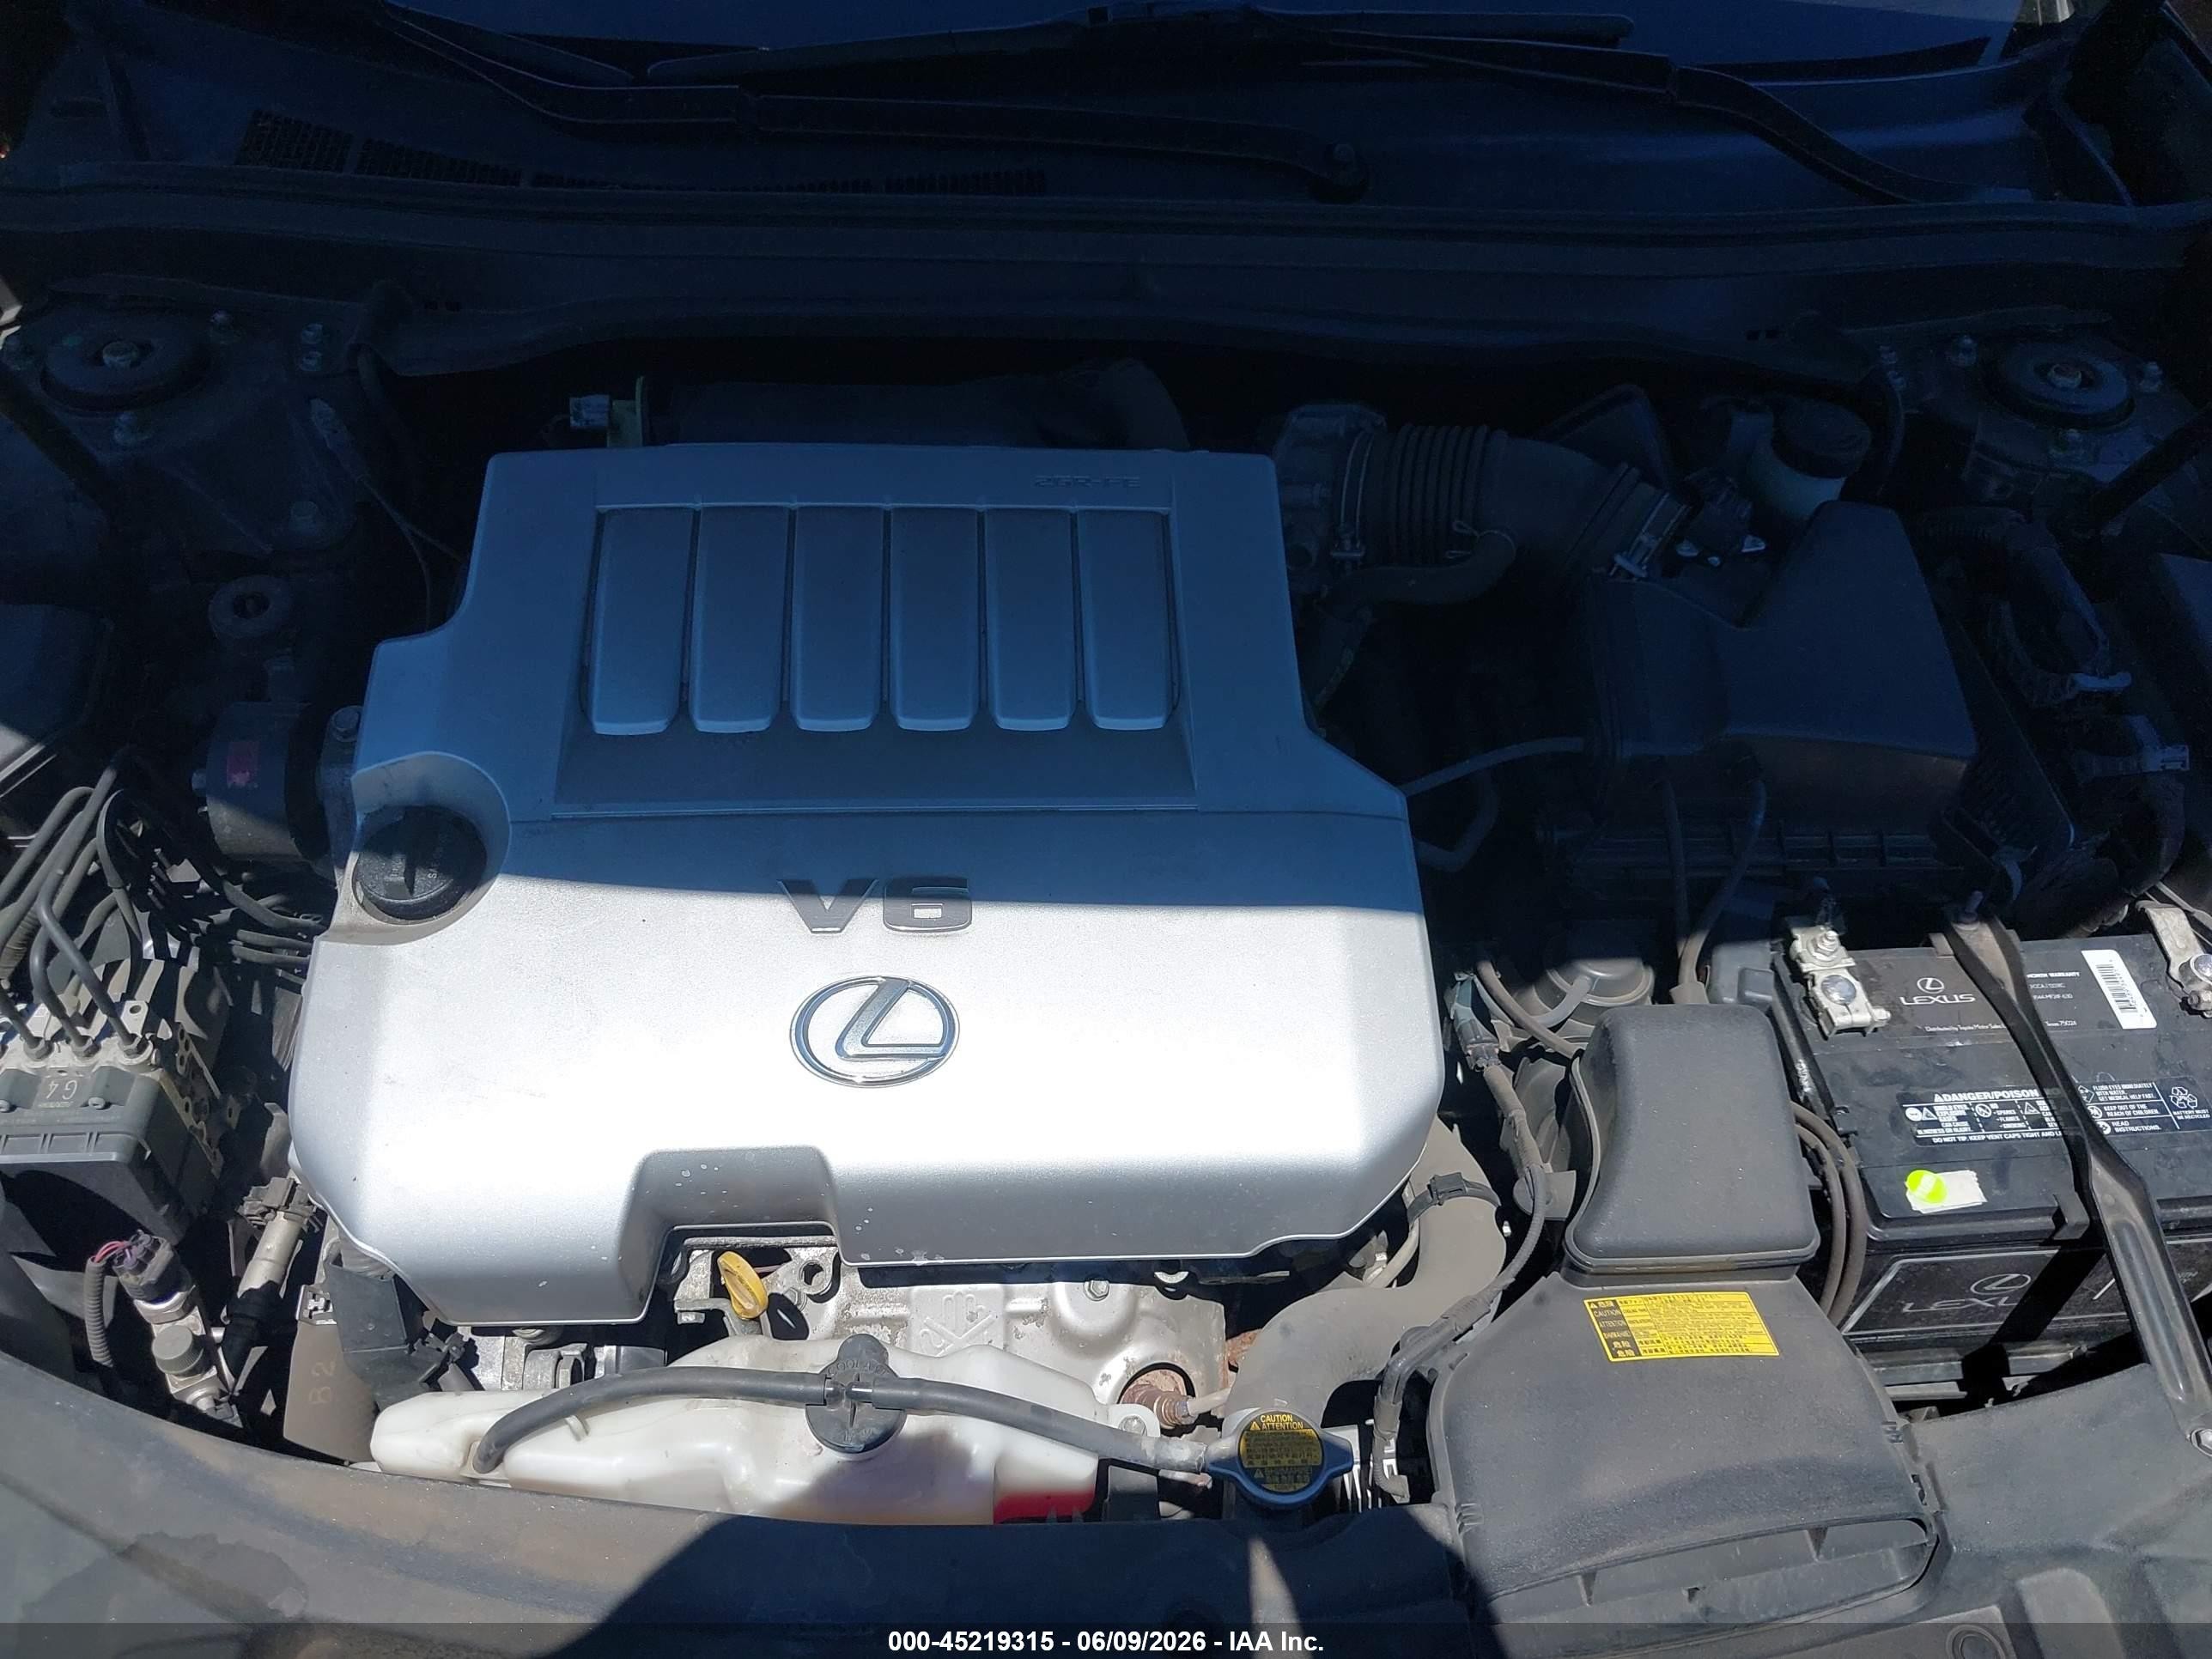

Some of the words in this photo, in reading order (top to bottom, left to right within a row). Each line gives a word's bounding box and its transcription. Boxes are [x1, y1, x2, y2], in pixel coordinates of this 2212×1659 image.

[776, 876, 973, 934] V6
[1899, 994, 1976, 1006] LEXUS
[1942, 1089, 2039, 1102] DANGER/POISON
[1260, 1413, 1293, 1423] CAUTION
[1261, 1421, 1304, 1431] ATTENTION
